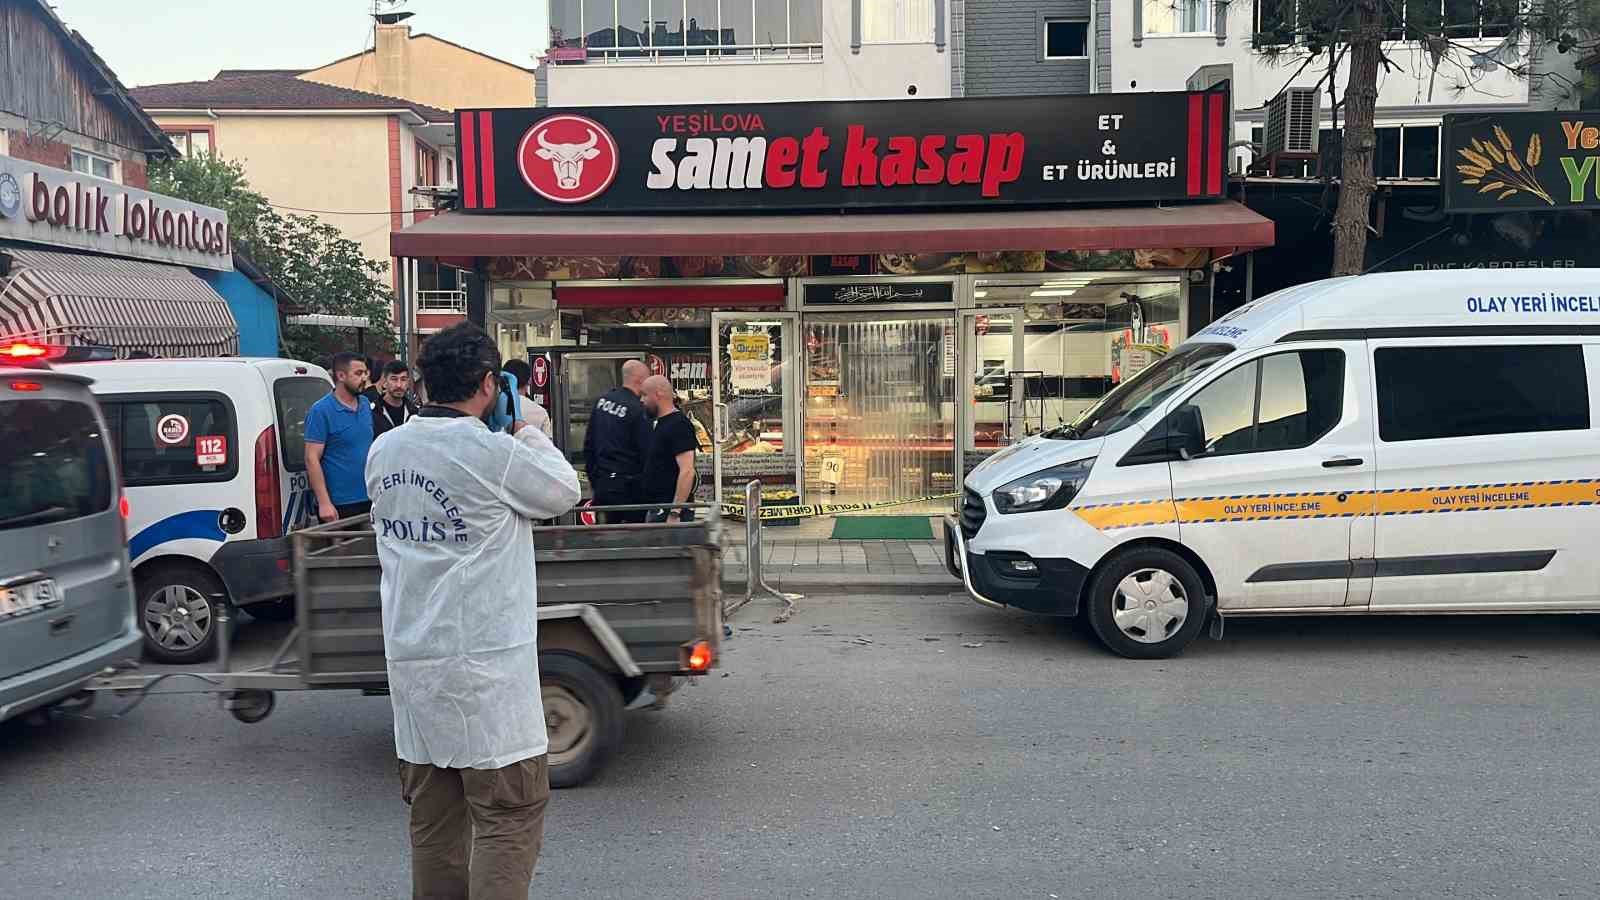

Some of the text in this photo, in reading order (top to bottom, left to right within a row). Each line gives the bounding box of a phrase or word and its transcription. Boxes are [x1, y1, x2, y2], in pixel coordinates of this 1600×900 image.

[656, 110, 765, 136] YEŞİLOVA
[1097, 114, 1123, 131] ET
[1560, 121, 1600, 149] Ye
[1102, 139, 1117, 156] &
[646, 124, 1025, 197] samet kasap
[1042, 157, 1176, 181] ET ÜRÜNLERİ
[1560, 156, 1600, 202] Y
[29, 172, 109, 233] balık
[119, 193, 230, 256] lokantası
[1466, 293, 1600, 312] OLAY YERİ İNCEL
[671, 362, 710, 379] sam
[597, 398, 628, 417] POLİS
[200, 439, 222, 454] 112
[378, 469, 406, 494] ERİ
[410, 469, 468, 542] İNCELEME
[1224, 504, 1248, 513] OLAY
[1249, 502, 1271, 512] YERİ
[1432, 492, 1529, 505] OLAY YERİ İNCELEME
[381, 516, 446, 542] POLİS
